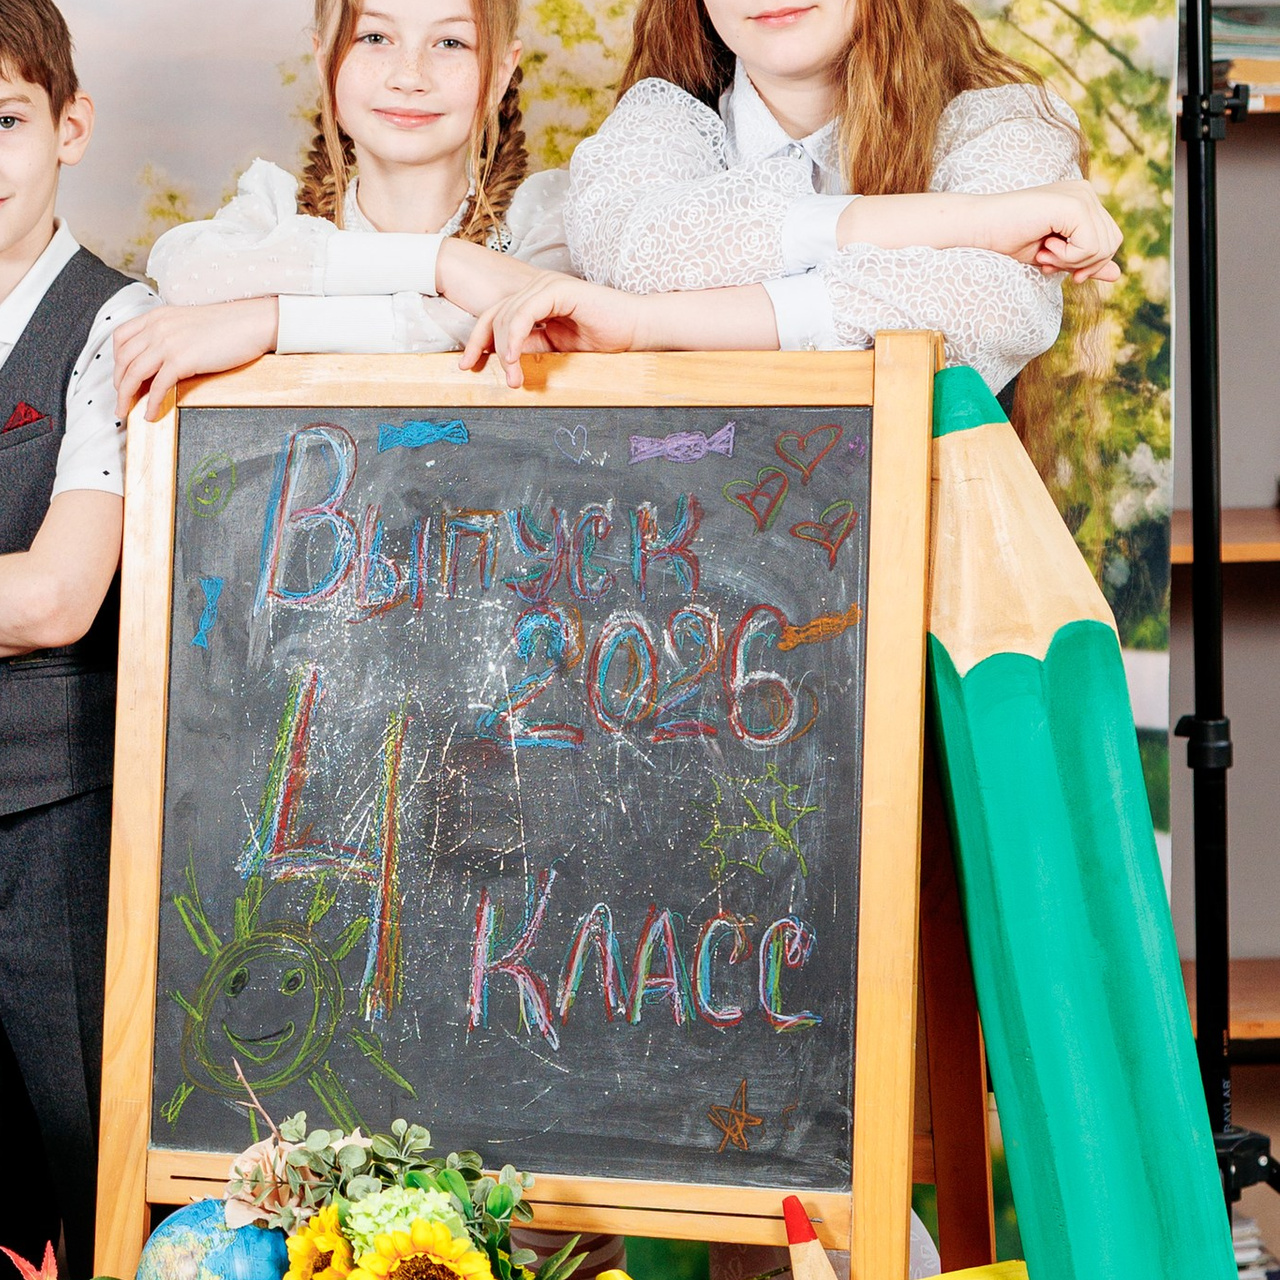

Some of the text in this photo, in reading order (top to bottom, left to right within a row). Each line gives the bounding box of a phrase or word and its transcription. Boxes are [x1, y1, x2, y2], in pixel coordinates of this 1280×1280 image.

[251, 422, 701, 620] Выпуск
[476, 600, 817, 750] 2026
[237, 661, 405, 1022] 4
